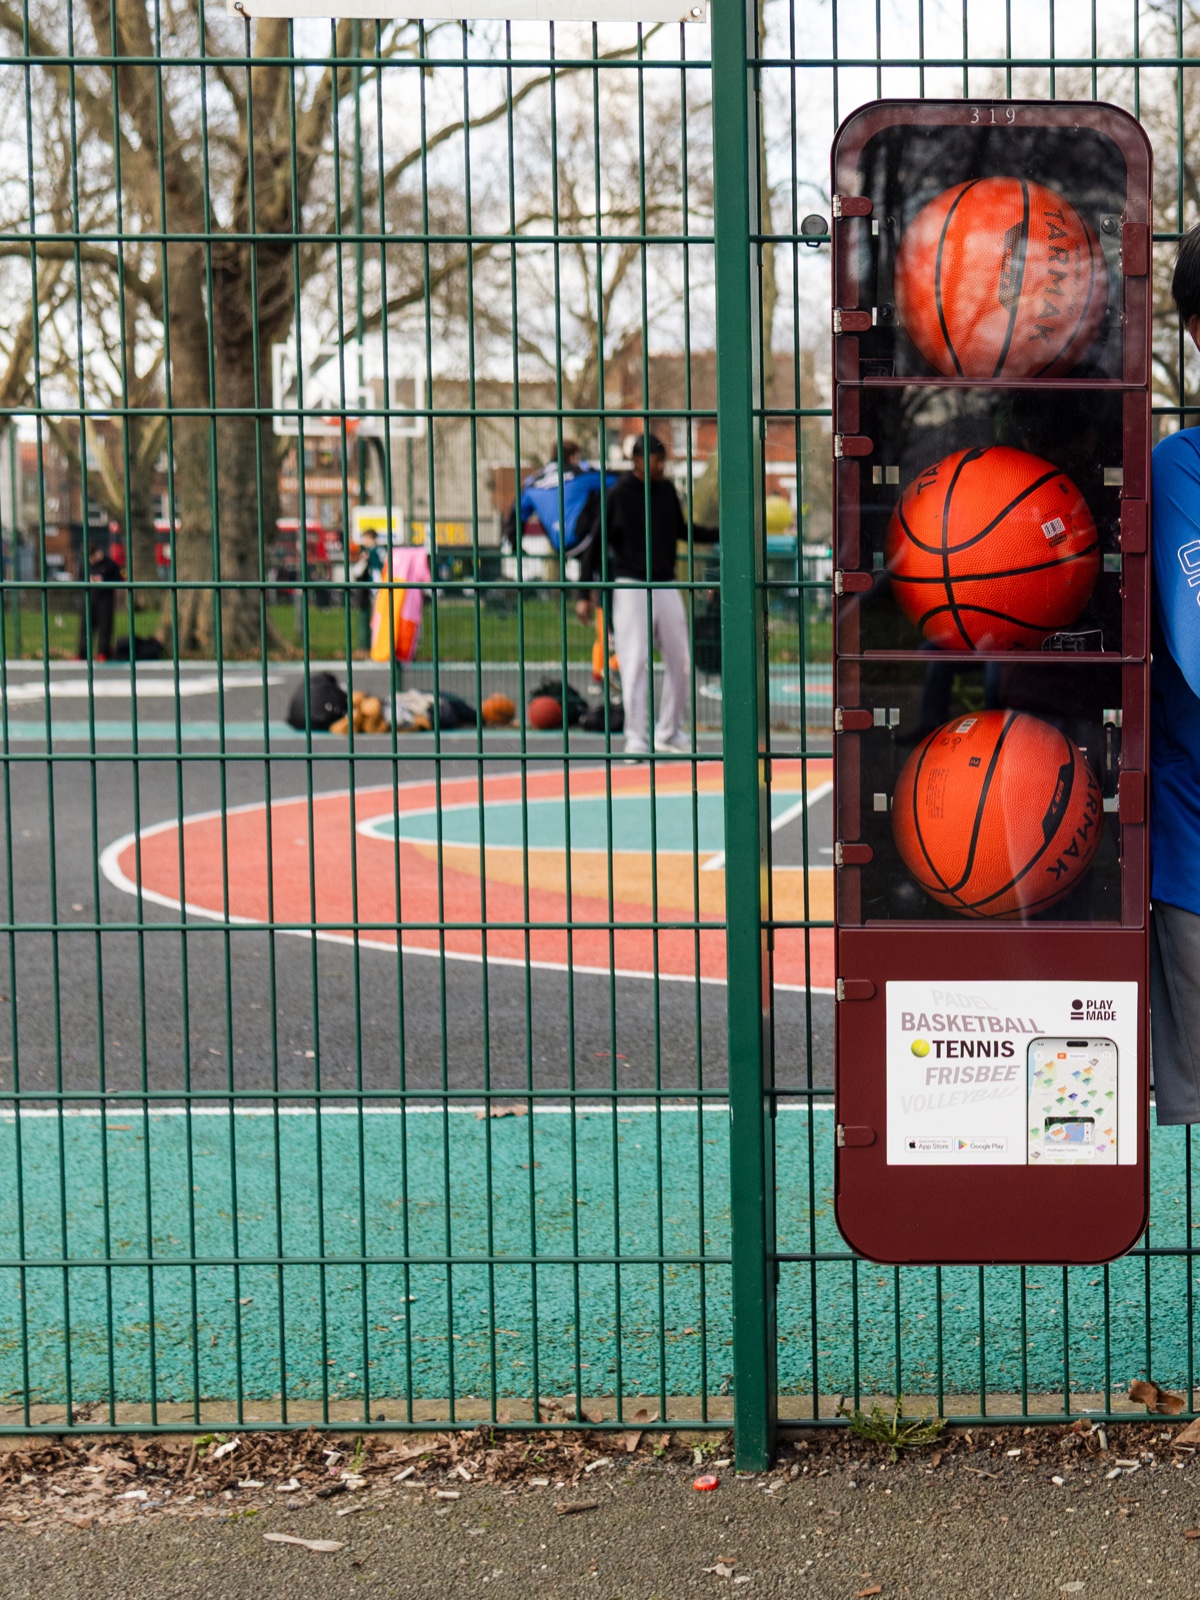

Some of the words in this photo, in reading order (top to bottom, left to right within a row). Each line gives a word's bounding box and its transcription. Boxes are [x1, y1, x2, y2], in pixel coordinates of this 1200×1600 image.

[1028, 210, 1070, 343] TARMAK
[931, 989, 999, 1011] PADEL
[1086, 1000, 1113, 1010] PLAY
[901, 1012, 1046, 1034] BASKETBALL
[1086, 1010, 1117, 1021] MADE
[932, 1040, 1015, 1059] TENNIS
[925, 1065, 1020, 1086] FRISBEE
